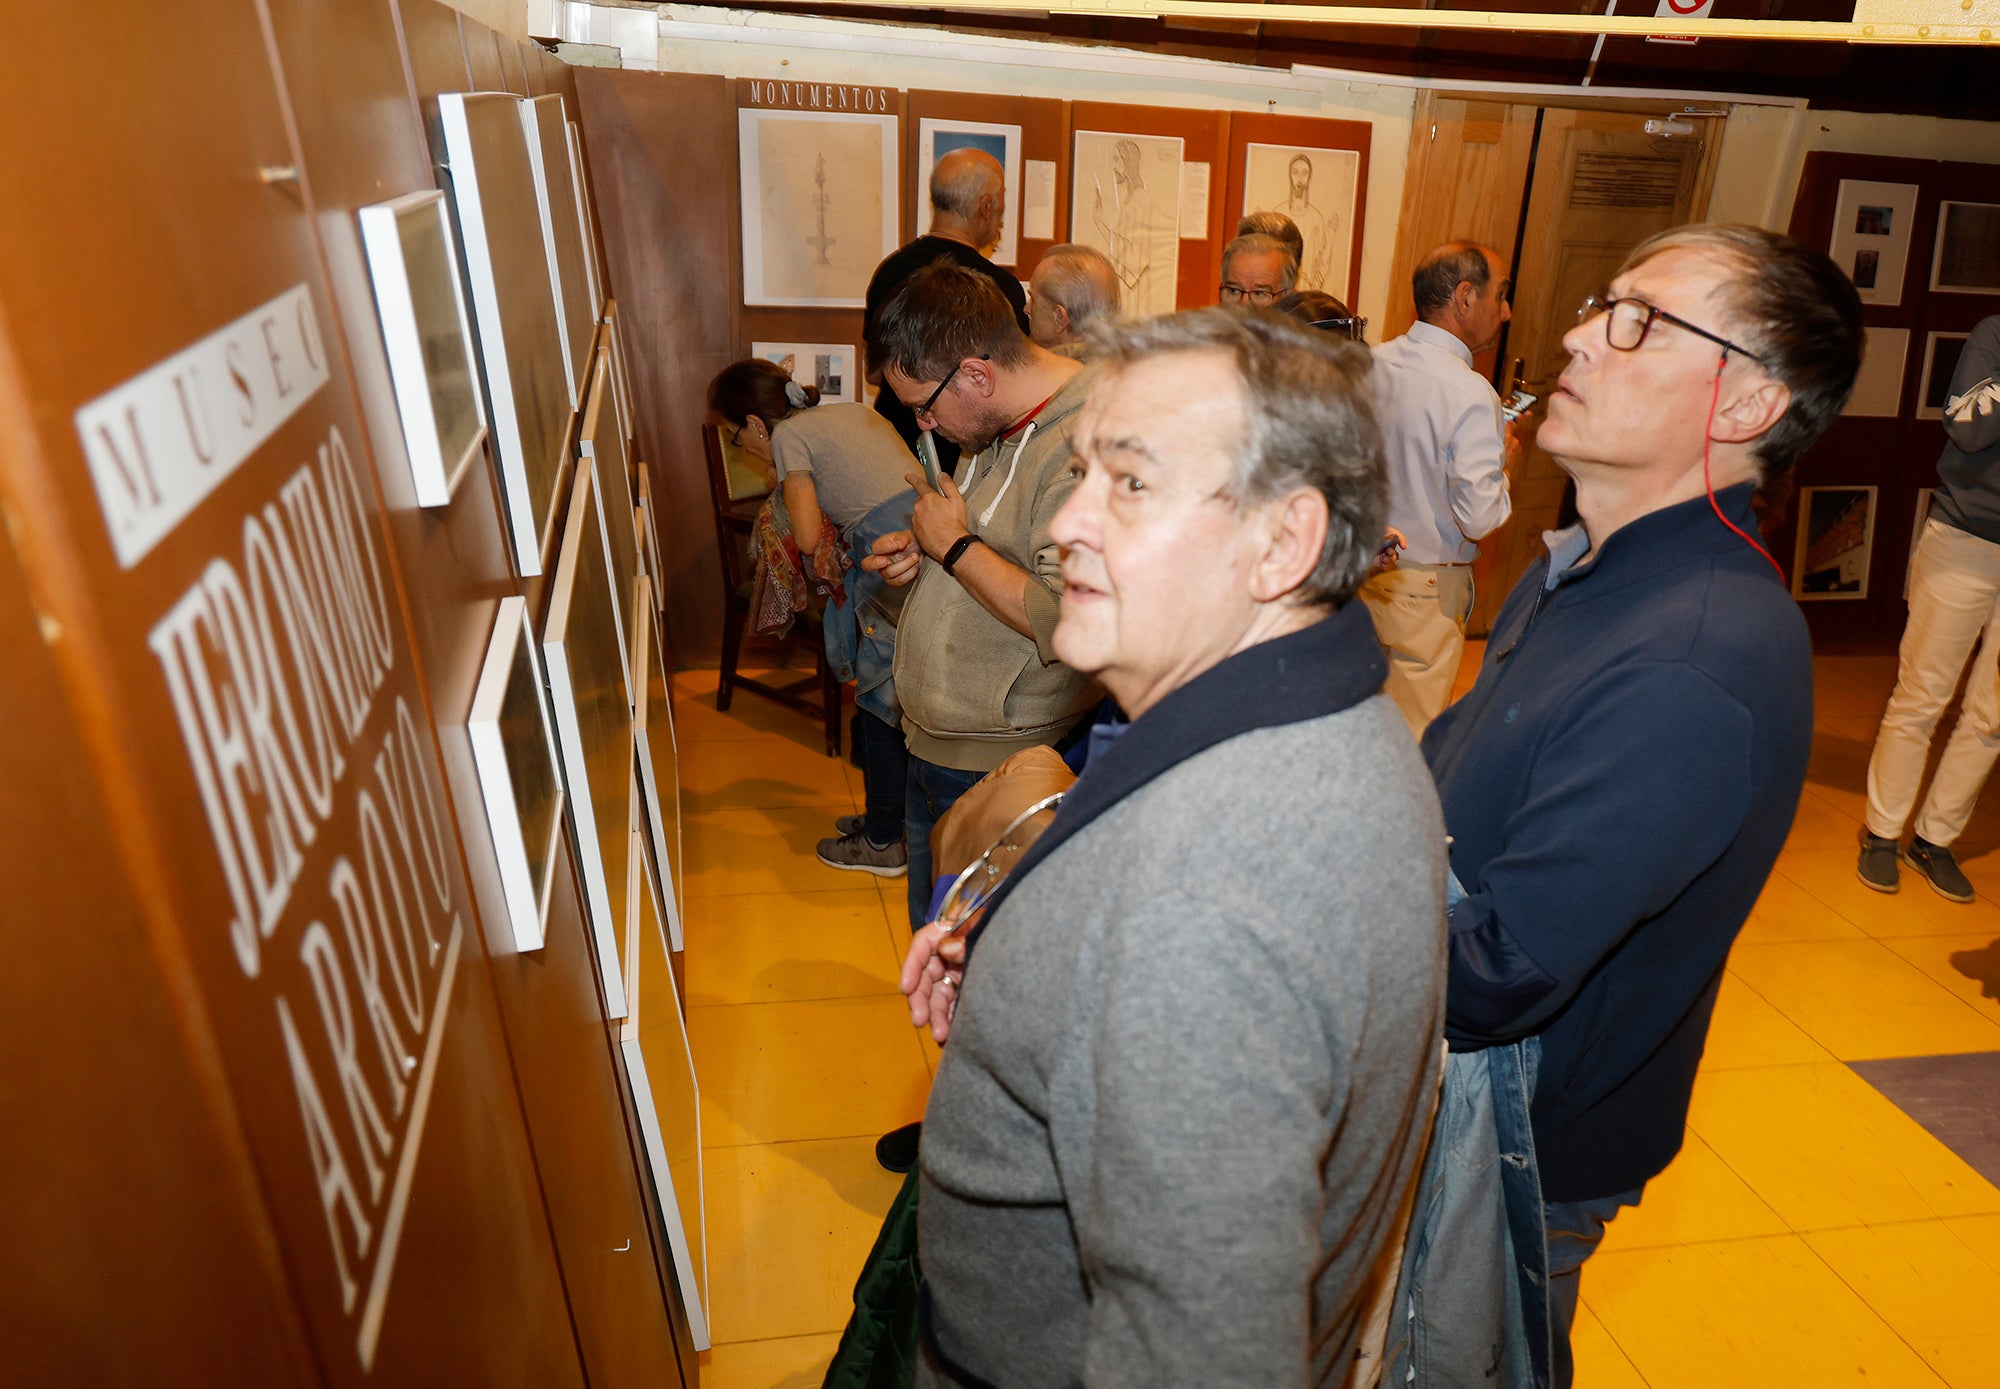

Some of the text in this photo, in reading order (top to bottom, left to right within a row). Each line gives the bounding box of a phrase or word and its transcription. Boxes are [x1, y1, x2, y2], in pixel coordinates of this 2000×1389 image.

[750, 80, 887, 112] MONUMENTOS
[149, 424, 394, 979] JERONIMO
[276, 695, 452, 1317] ARROYO
